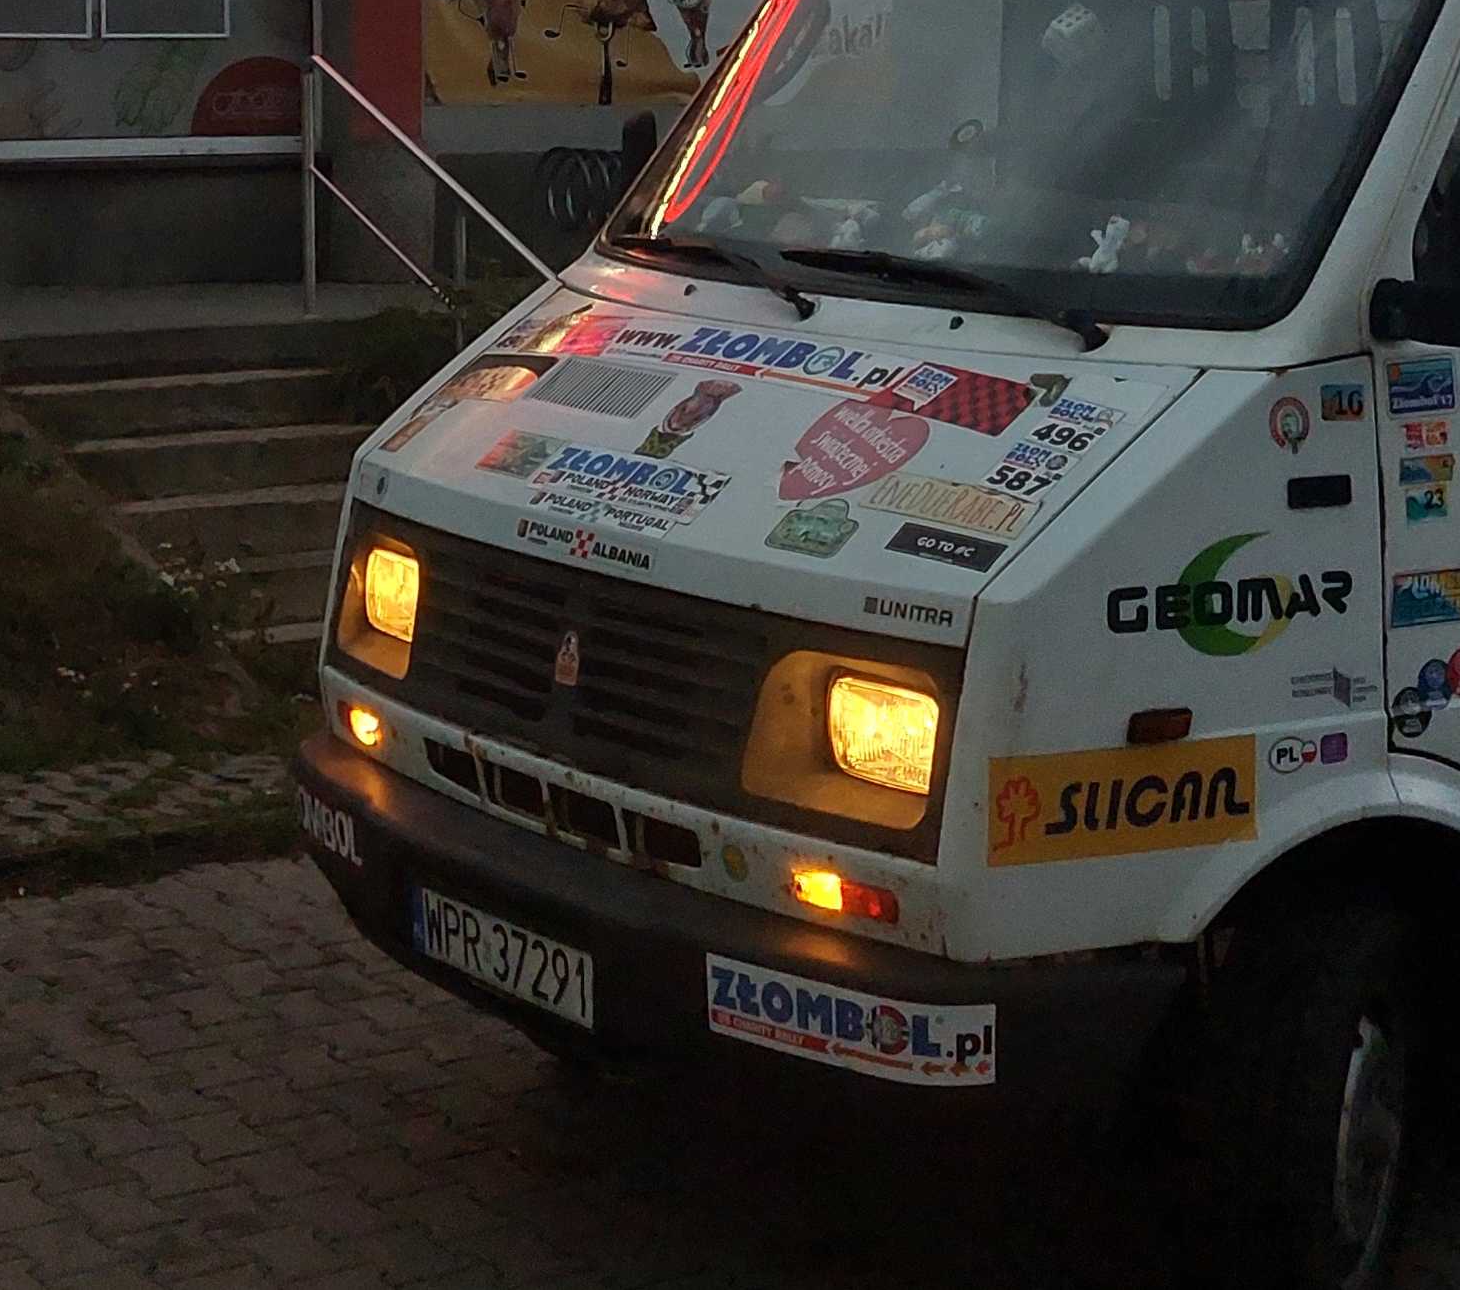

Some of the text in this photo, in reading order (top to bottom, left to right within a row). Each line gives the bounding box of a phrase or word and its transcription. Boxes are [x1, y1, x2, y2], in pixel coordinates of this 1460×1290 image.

[615, 327, 904, 390] www.ZŁOMBOL.pl
[1032, 423, 1095, 452] 496
[547, 447, 692, 495] ZŁOMBOL
[563, 472, 609, 490] POLAND
[624, 486, 679, 507] NORWAY
[986, 465, 1052, 495] 587
[544, 493, 592, 513] POLAND
[605, 508, 674, 532] PORTUGAL
[530, 521, 651, 570] POLAND ALBANIA
[880, 599, 953, 628] UNITRA
[1107, 570, 1353, 634] GEOMAR
[1276, 746, 1299, 764] PL
[425, 893, 586, 1018] WPR 37291
[712, 965, 993, 1063] ZŁOMBOL.pl
